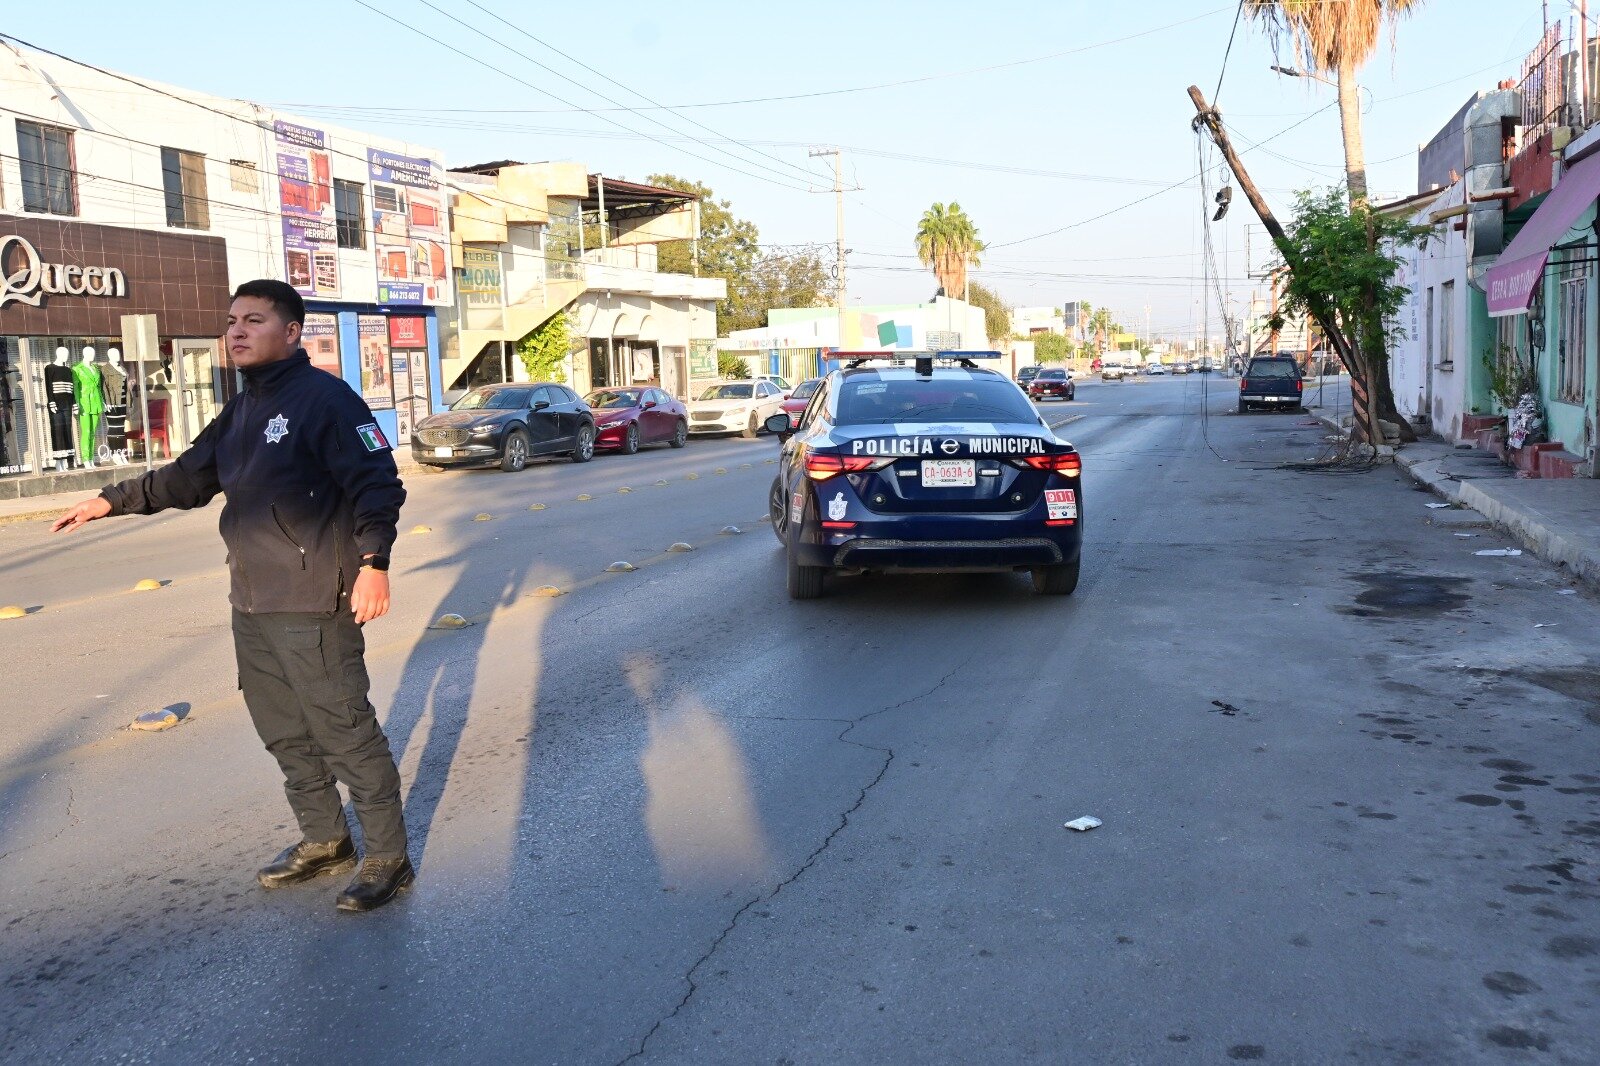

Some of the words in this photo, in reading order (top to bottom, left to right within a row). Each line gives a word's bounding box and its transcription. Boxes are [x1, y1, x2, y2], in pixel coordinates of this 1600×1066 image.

[382, 157, 405, 169] PORTONES
[390, 170, 438, 188] AMERICANOS
[0, 235, 125, 308] Queen
[97, 444, 134, 462] Queen
[852, 436, 934, 455] POLICÍA
[969, 438, 1046, 454] MUNICIPAL
[924, 466, 973, 479] CA-063A-6
[1048, 491, 1073, 502] 911
